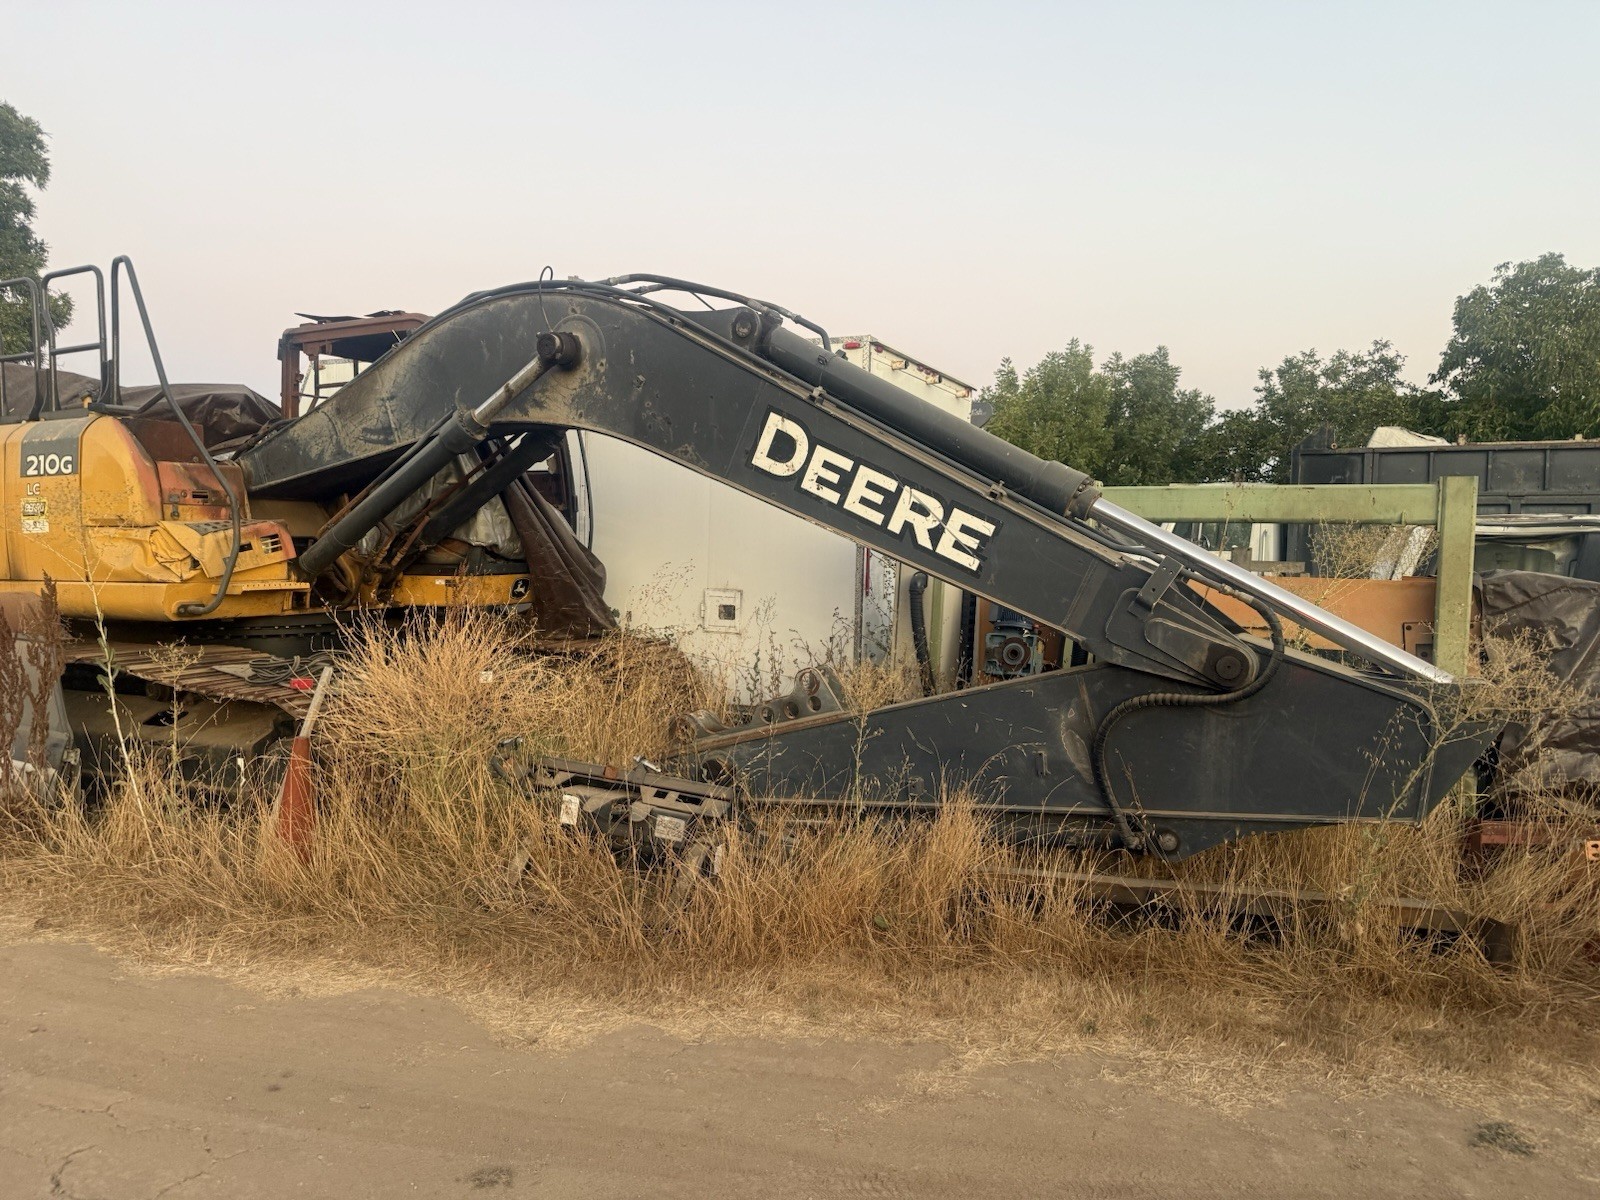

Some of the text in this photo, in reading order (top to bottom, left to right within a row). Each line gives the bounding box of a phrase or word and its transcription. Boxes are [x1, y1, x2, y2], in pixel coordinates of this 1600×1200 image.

[26, 453, 73, 476] 210G
[27, 483, 40, 496] LC
[751, 411, 996, 572] DEERE
